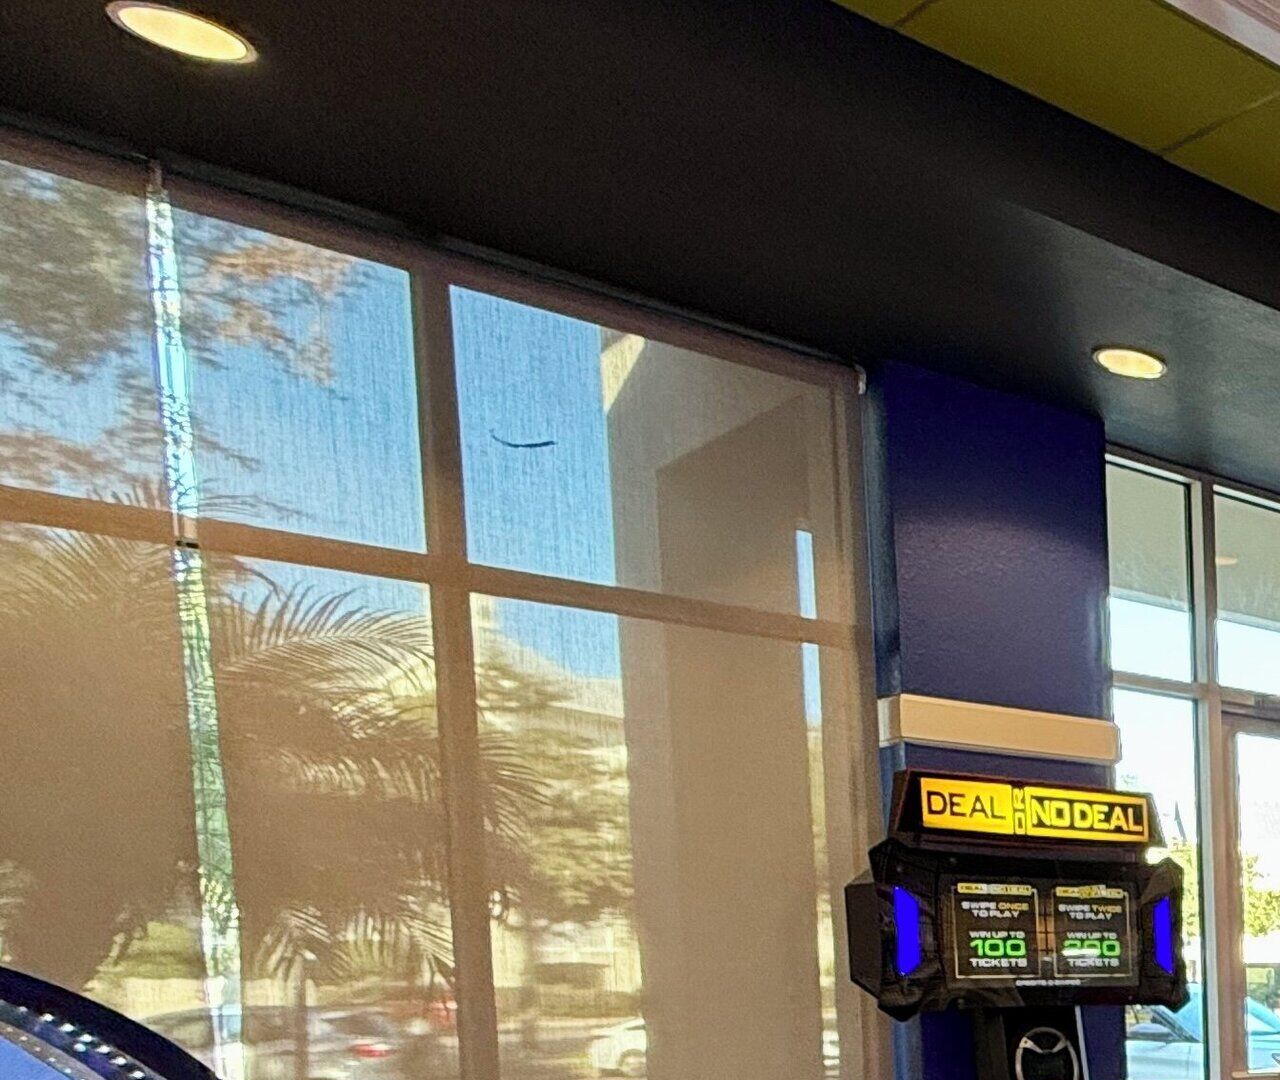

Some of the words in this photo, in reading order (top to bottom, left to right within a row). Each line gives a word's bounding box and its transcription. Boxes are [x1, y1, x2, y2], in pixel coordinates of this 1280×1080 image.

[926, 790, 1007, 820] DEAL
[1012, 787, 1025, 835] OR
[1031, 798, 1071, 828] NO
[1073, 804, 1144, 832] DEAL
[961, 902, 997, 910] SWIPE
[998, 902, 1030, 911] ONCE
[1058, 903, 1091, 912] SWIPE
[1092, 904, 1122, 913] TWICE
[972, 910, 987, 918] TO
[989, 910, 1020, 918] PLAY
[1069, 912, 1084, 920] TO
[1085, 912, 1113, 920] PLAY
[969, 931, 990, 939] WIN
[992, 931, 1008, 939] UP
[1009, 931, 1026, 939] TO
[1066, 932, 1086, 940] WIN
[1087, 932, 1102, 940] UP
[1103, 932, 1117, 940] TO
[970, 939, 1026, 956] 100
[969, 957, 1028, 968] TICKETS
[1067, 957, 1120, 968] TICKETS
